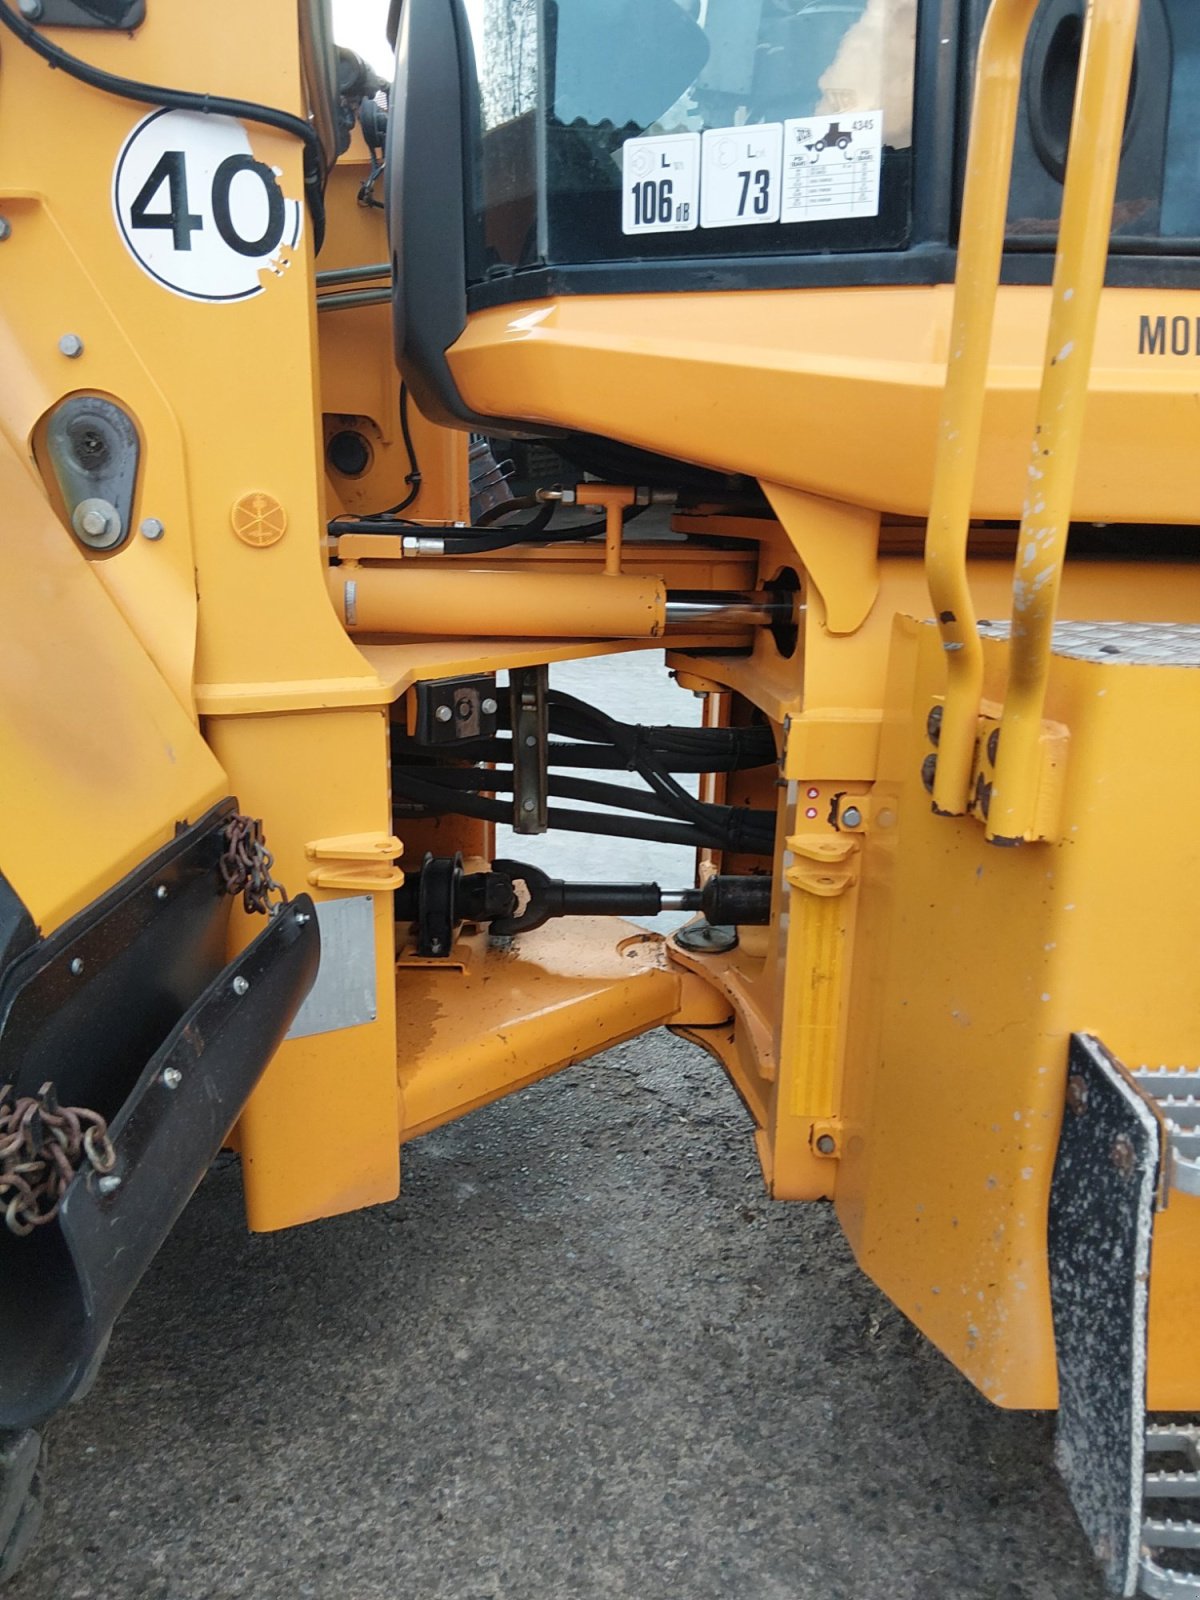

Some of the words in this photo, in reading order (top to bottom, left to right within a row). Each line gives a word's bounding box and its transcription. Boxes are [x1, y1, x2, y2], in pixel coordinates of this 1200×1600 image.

[130, 151, 286, 257] 40
[632, 179, 673, 225] 106
[676, 202, 690, 222] dB
[737, 169, 770, 216] 73
